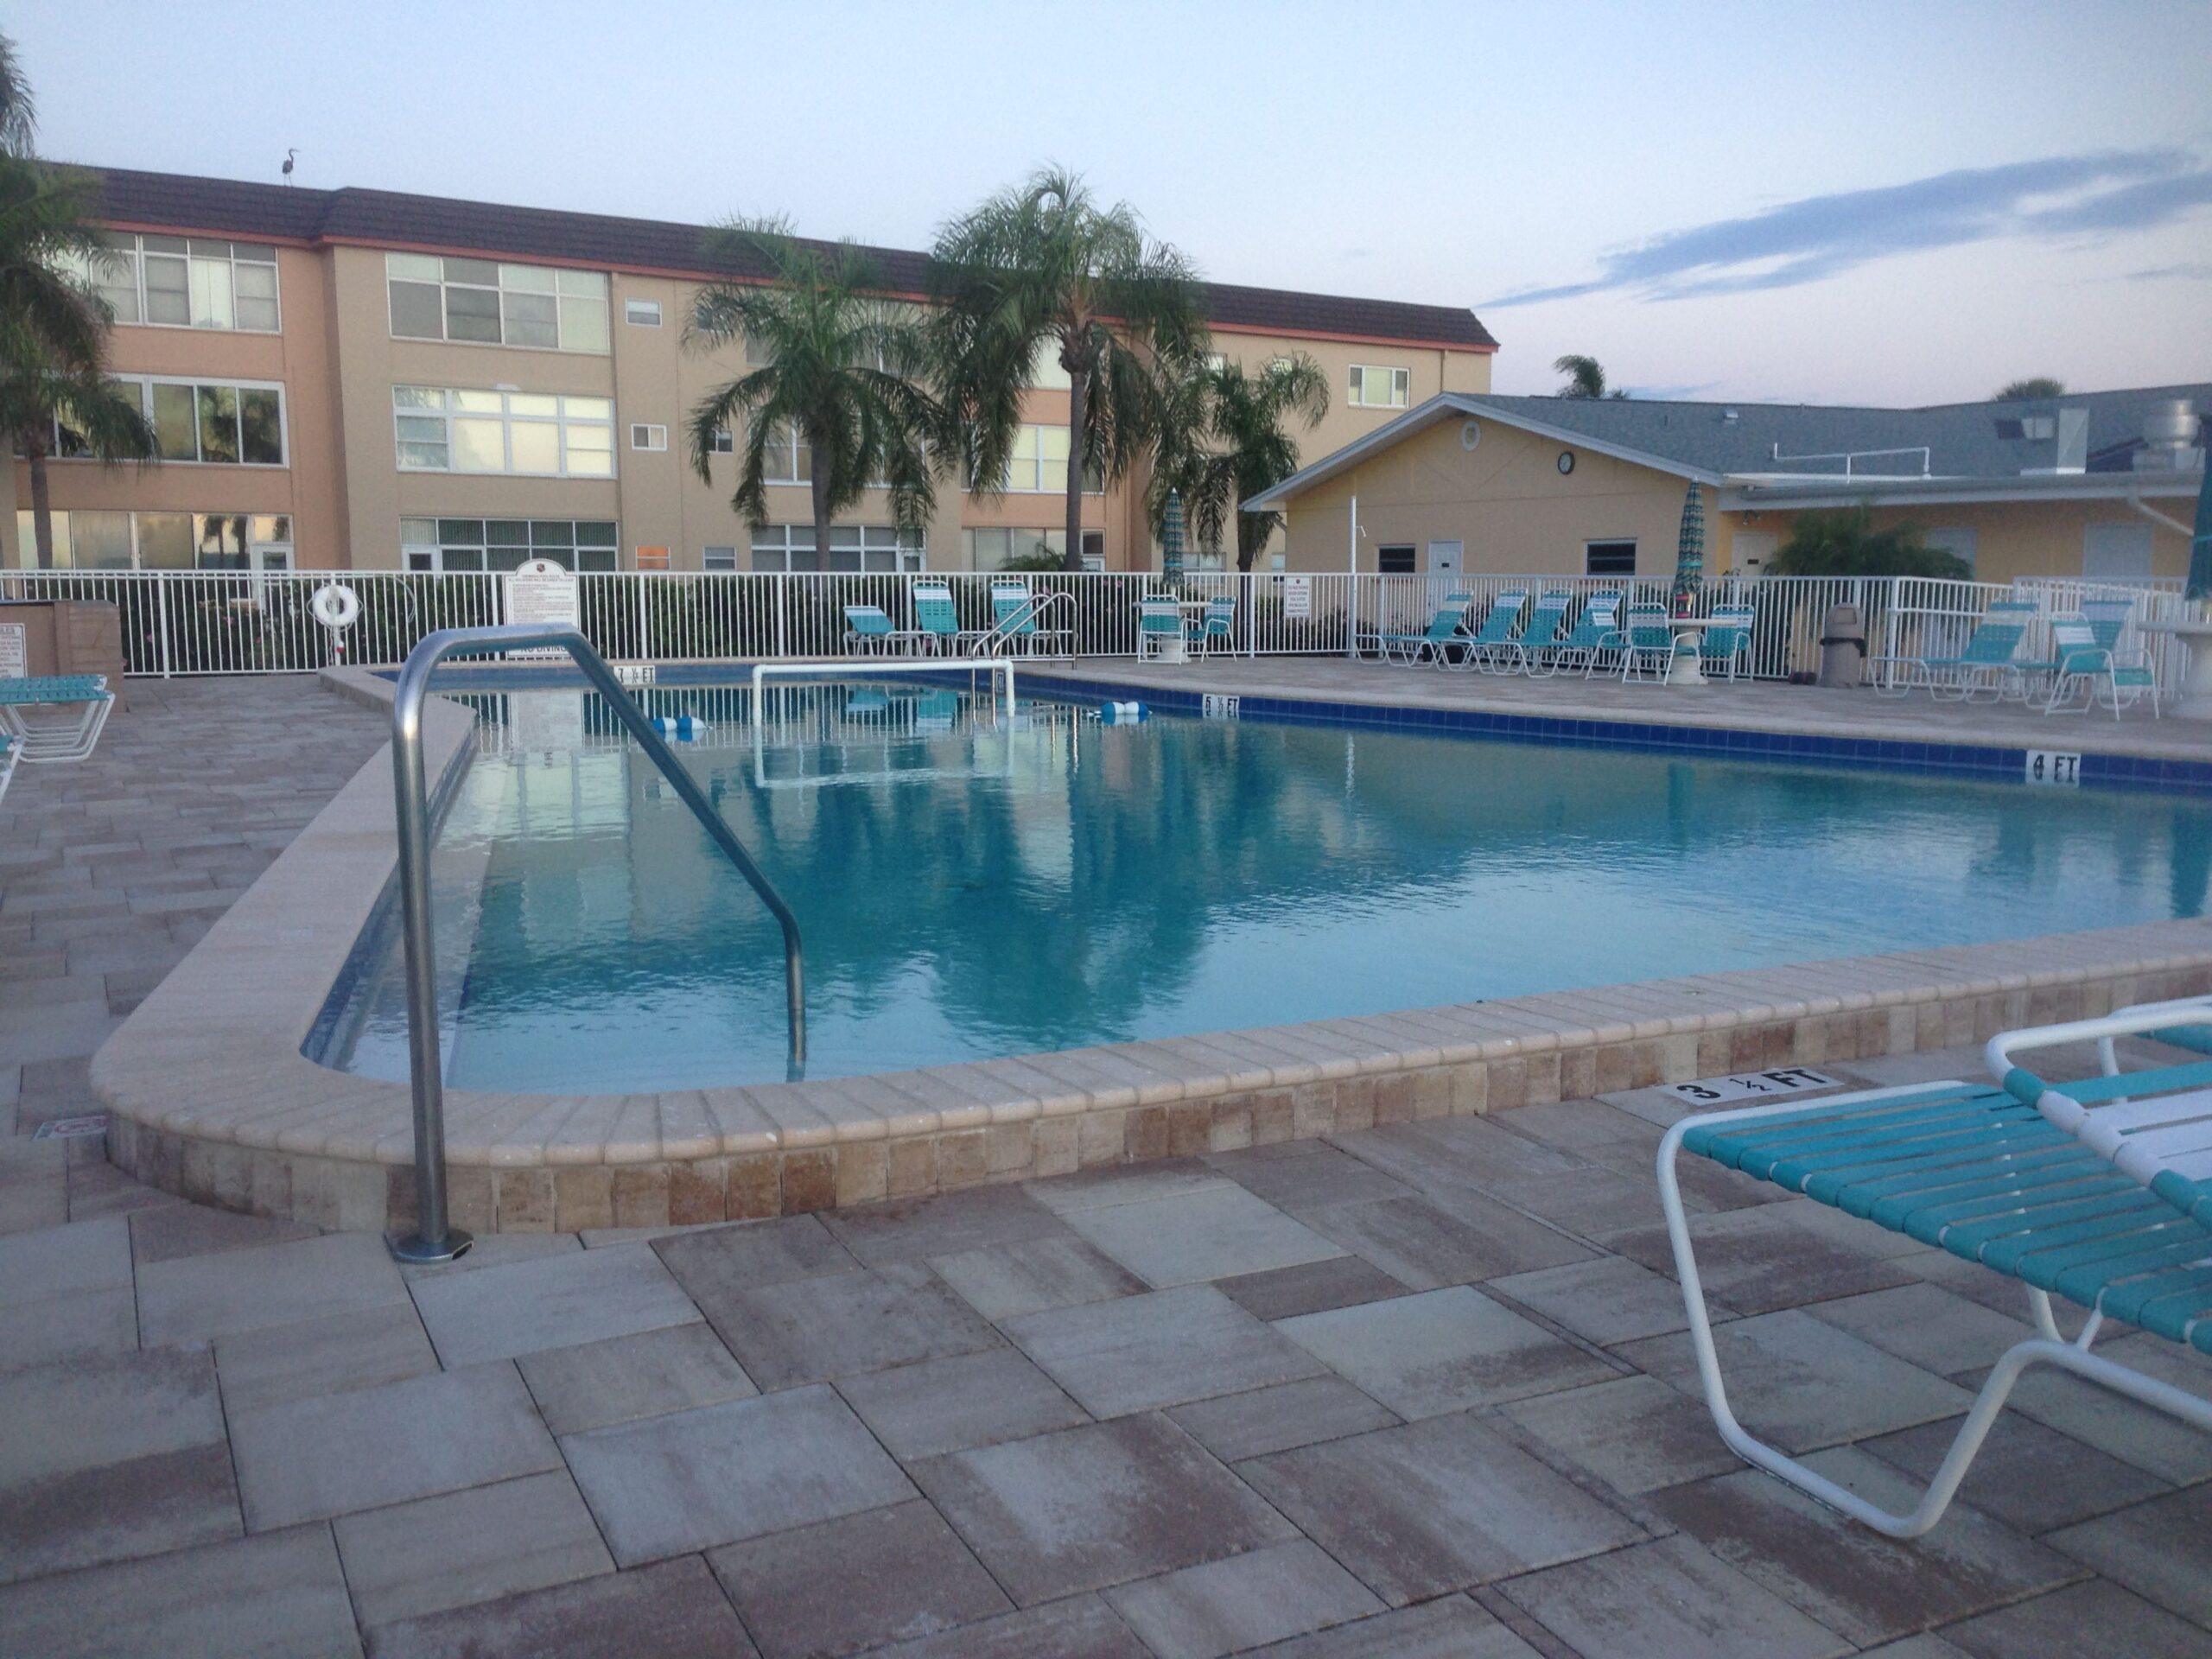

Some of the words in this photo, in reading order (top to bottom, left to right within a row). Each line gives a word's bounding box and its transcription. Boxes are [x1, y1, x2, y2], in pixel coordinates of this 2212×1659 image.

[618, 667, 624, 681] 7
[642, 667, 654, 681] FT
[1227, 698, 1237, 715] FT
[2033, 754, 2044, 778] 4
[2054, 755, 2077, 779] FT
[1676, 1084, 1721, 1099] 3
[1761, 1069, 1827, 1088] FT
